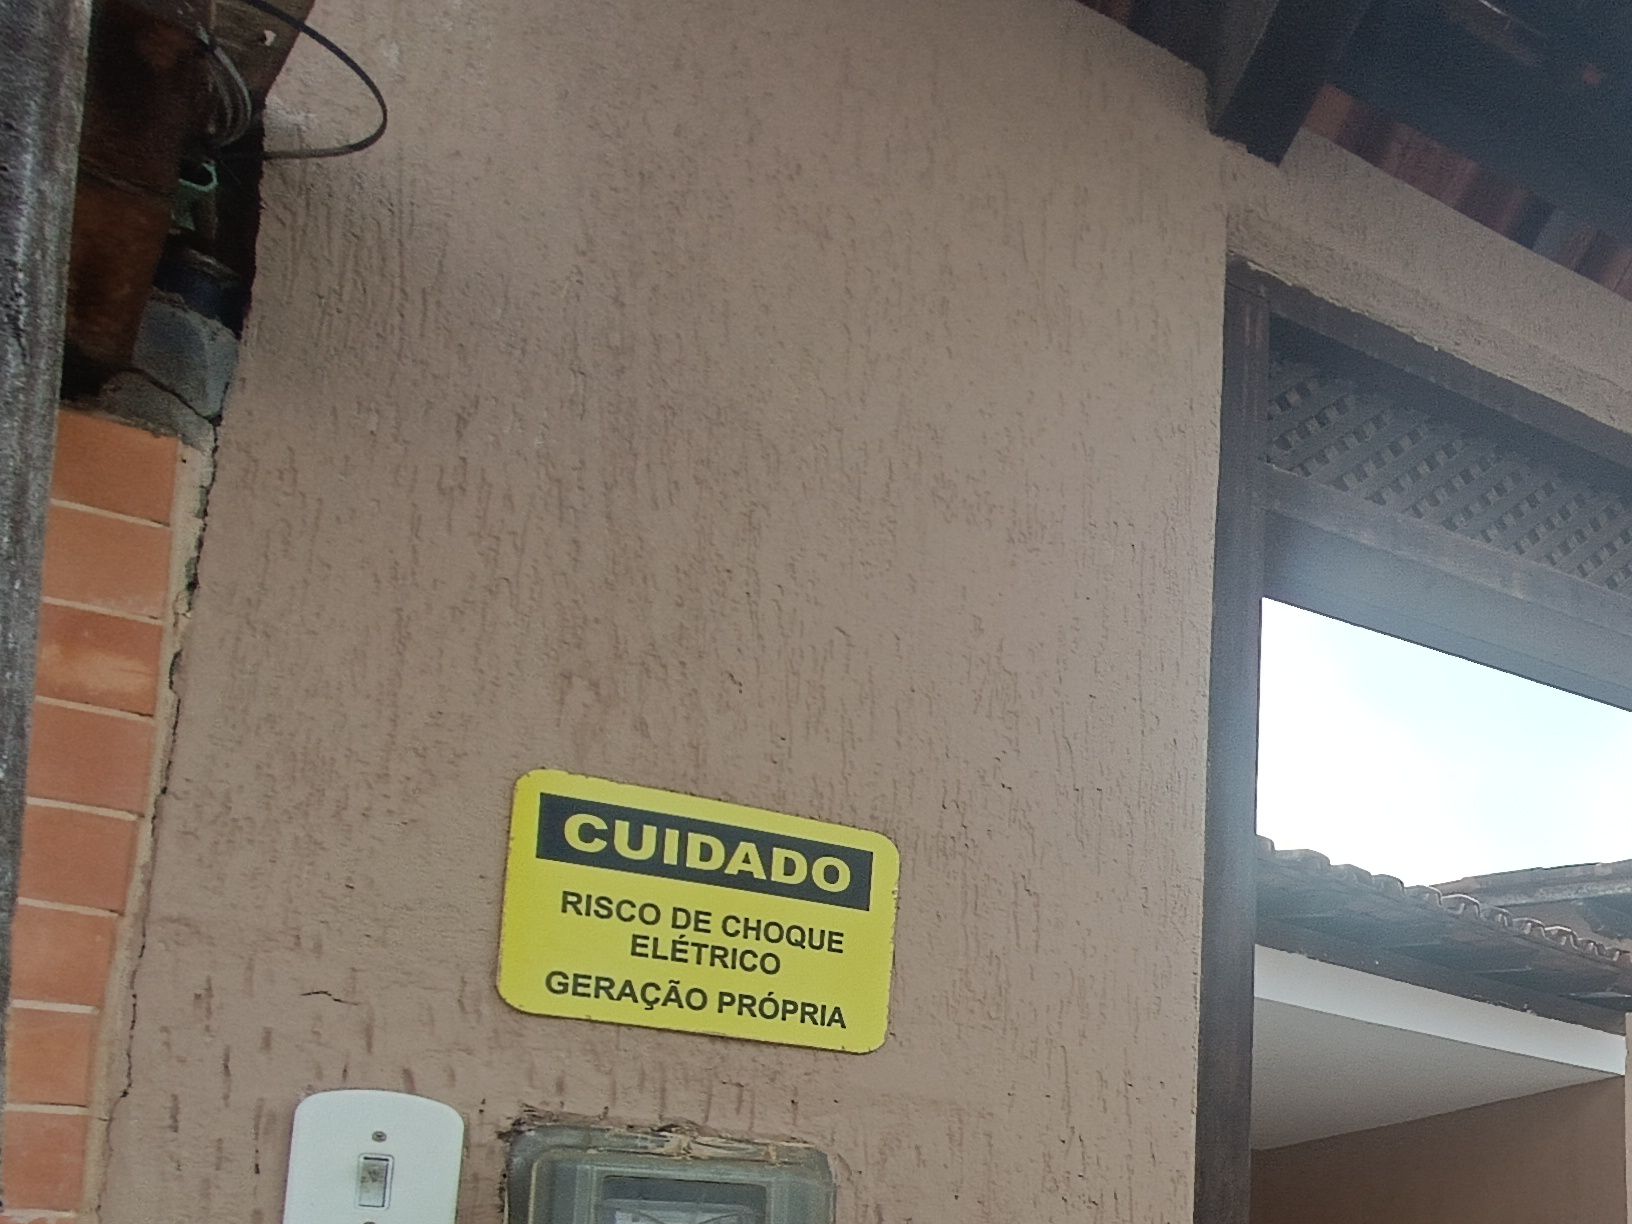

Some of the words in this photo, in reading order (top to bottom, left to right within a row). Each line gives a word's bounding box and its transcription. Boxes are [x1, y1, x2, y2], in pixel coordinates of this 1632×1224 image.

[563, 812, 852, 893] CUIDADO
[560, 890, 661, 926] RISCO
[671, 907, 712, 933] DE
[721, 914, 845, 953] CHOQUE
[629, 934, 781, 976] ELÉTRICO
[544, 970, 708, 1011] GERAÇÃO
[716, 991, 847, 1029] PRÓPRIA
